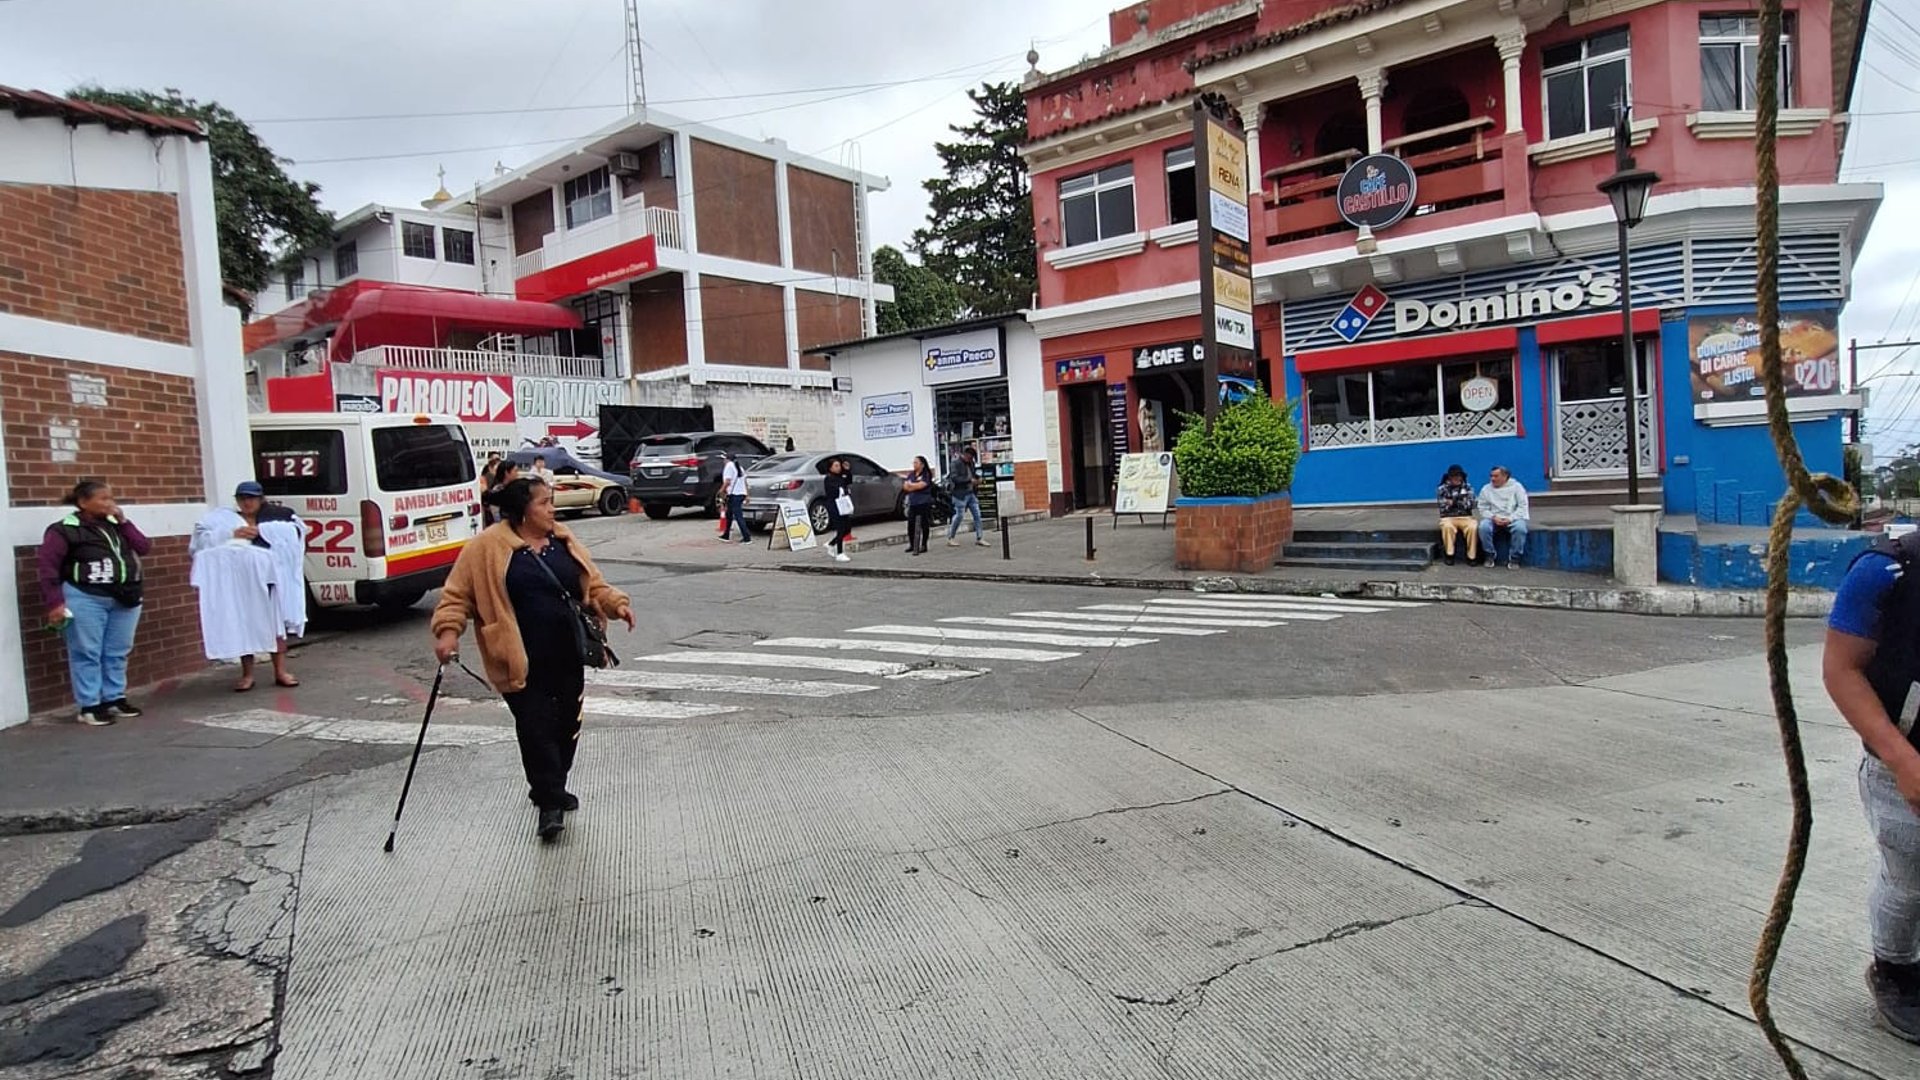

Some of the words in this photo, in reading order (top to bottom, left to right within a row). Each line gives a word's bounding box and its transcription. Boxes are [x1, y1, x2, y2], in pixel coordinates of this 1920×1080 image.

[1344, 182, 1409, 215] CASTILLO
[1394, 270, 1619, 333] Domino's
[1152, 346, 1185, 366] CAFE
[1700, 359, 1713, 374] DI
[1713, 351, 1748, 373] CARNE
[382, 376, 488, 417] PARQUEO
[516, 379, 561, 418] CAR
[562, 380, 624, 418] WASH
[1463, 386, 1493, 400] OPEN
[306, 497, 338, 512] MIXCO
[394, 488, 474, 512] AMBULANCIA
[304, 519, 356, 554] 22
[326, 555, 357, 568] CIA.
[320, 584, 332, 602] 22
